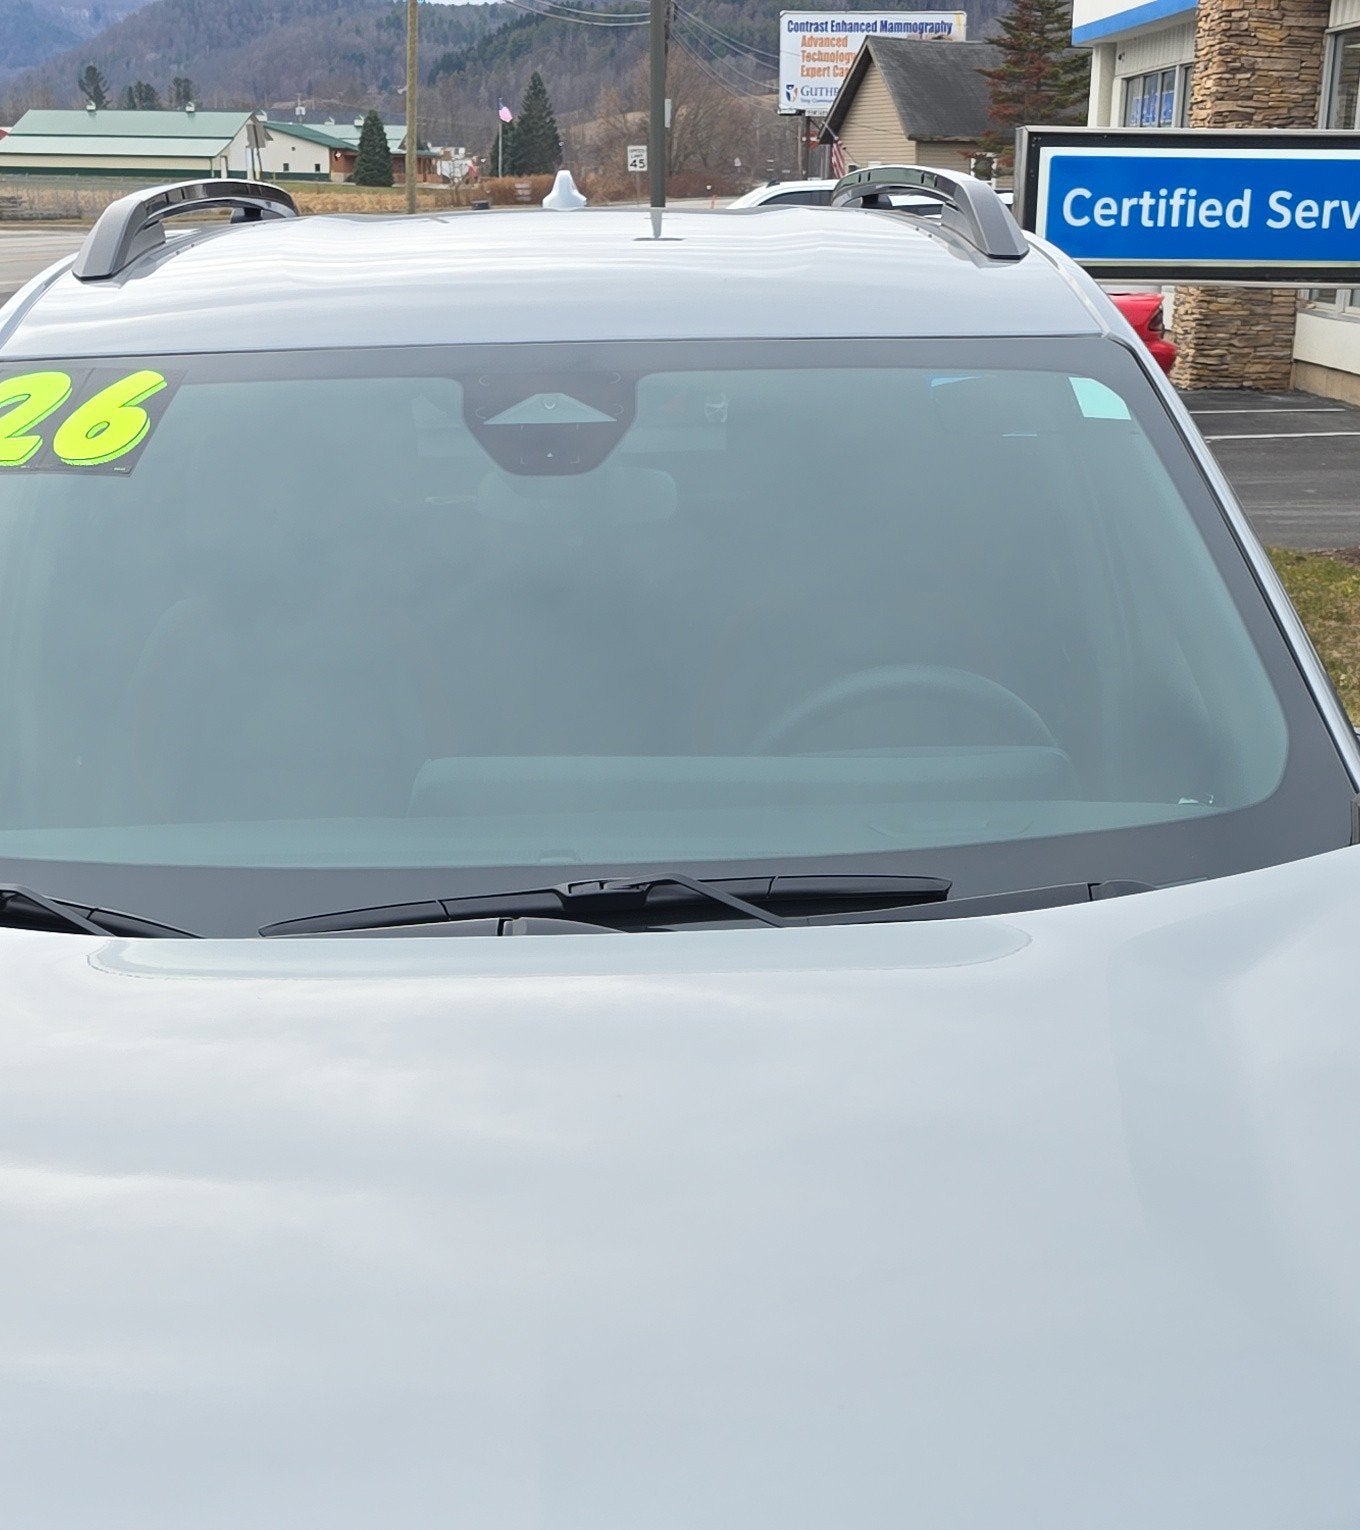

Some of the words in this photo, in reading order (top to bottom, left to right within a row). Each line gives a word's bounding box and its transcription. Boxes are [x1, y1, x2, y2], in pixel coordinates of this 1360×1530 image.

[787, 20, 828, 32] Contrast
[831, 20, 877, 32] Enhanced
[880, 20, 953, 35] Mammography
[801, 35, 847, 47] Advanced
[801, 65, 830, 78] Expert
[630, 159, 645, 168] 45
[1062, 187, 1252, 229] Certified
